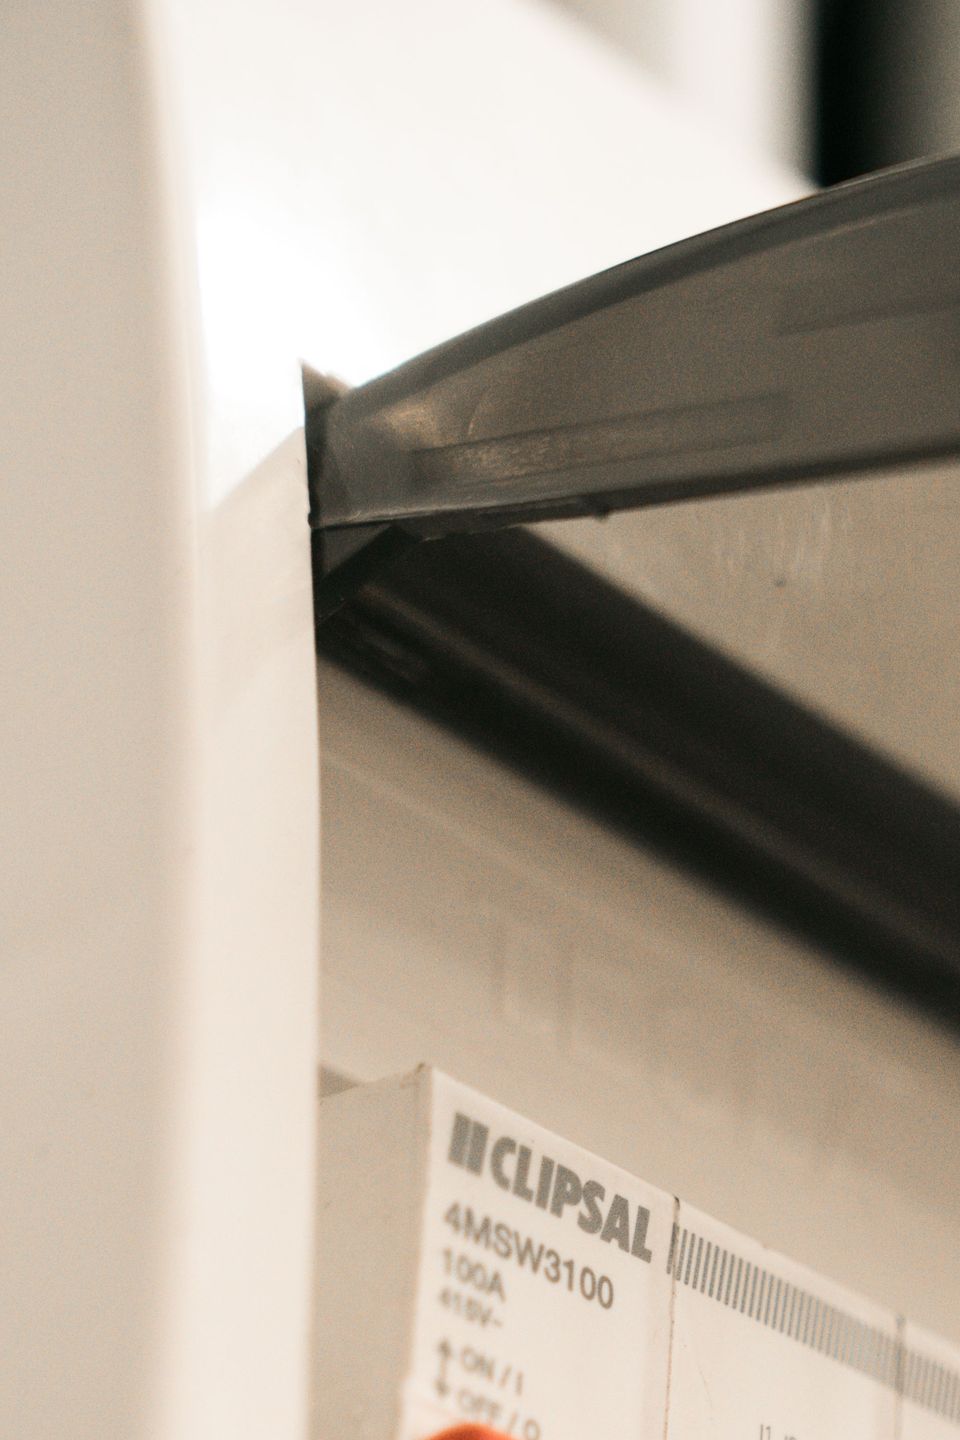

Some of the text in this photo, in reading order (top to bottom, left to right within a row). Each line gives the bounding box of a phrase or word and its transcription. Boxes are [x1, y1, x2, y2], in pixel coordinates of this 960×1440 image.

[490, 1136, 653, 1264] CLIPSAL
[443, 1202, 615, 1311] 4MSW3100
[443, 1247, 507, 1304] 100A
